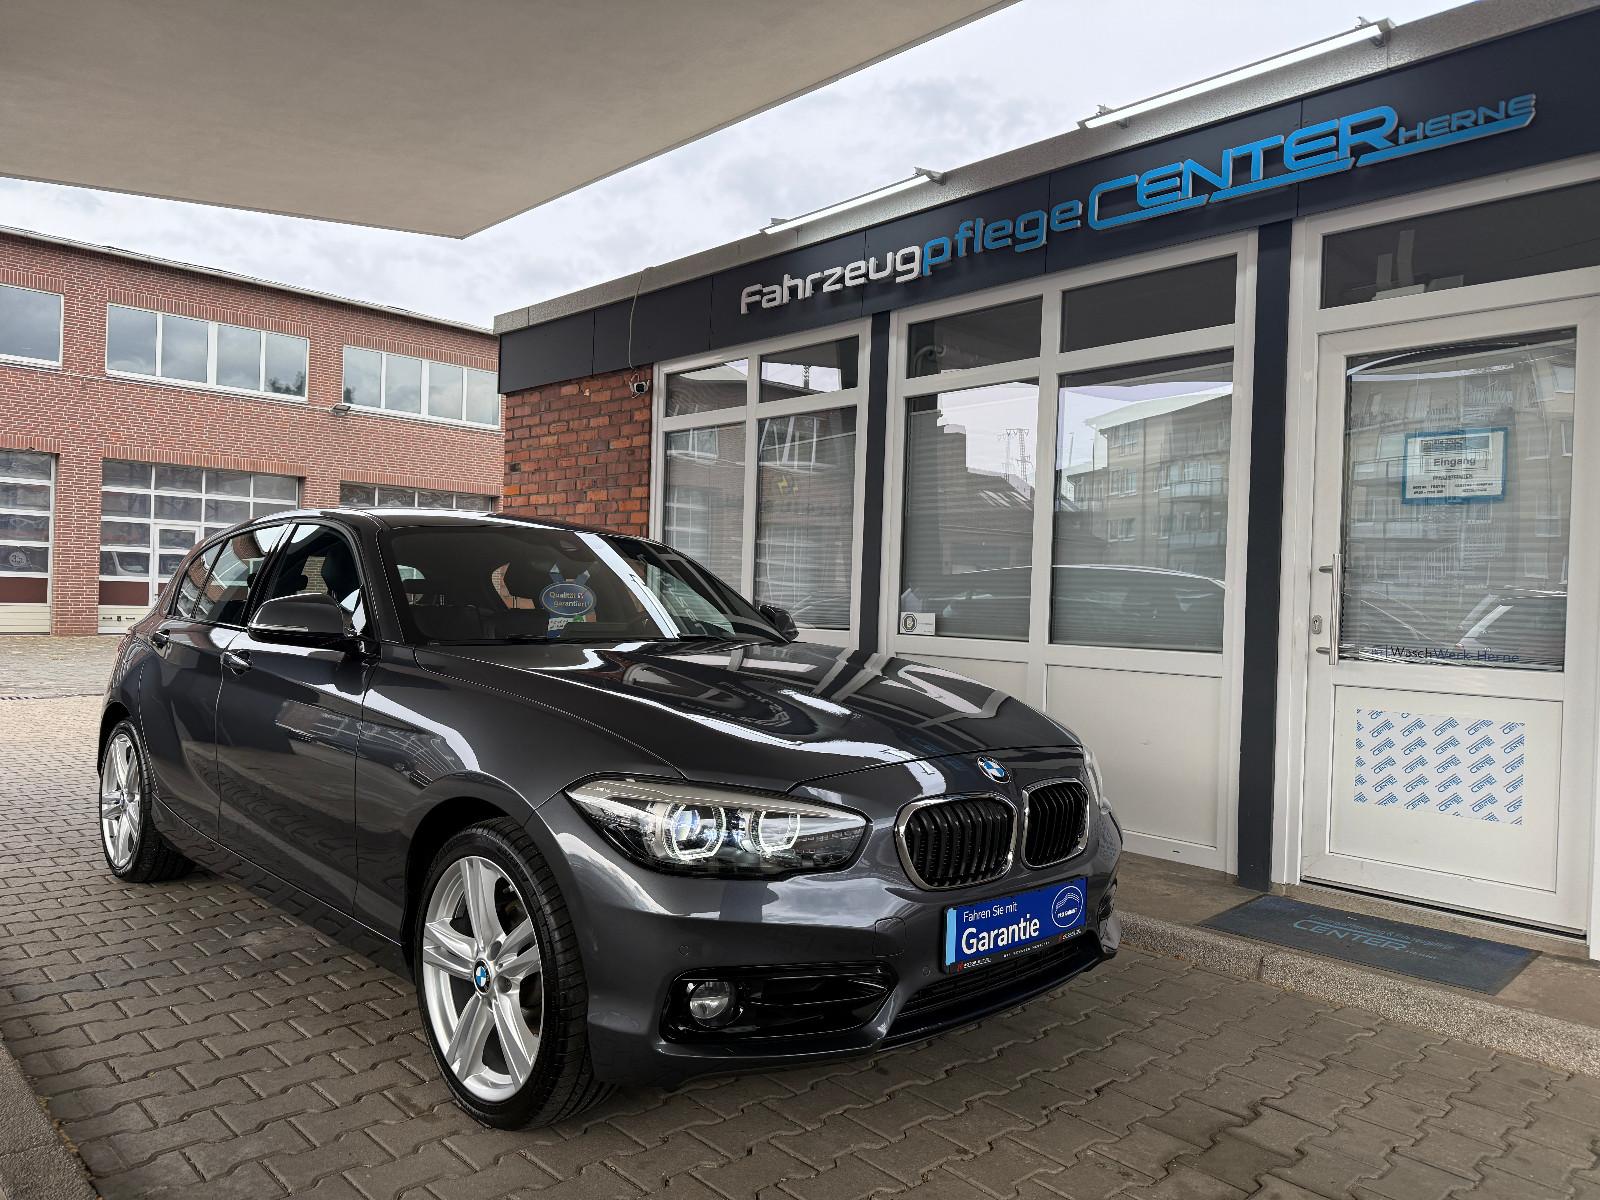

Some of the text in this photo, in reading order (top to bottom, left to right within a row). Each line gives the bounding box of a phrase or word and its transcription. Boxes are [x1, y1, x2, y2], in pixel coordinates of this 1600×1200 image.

[1088, 105, 1399, 231] CENTER
[1398, 94, 1536, 144] HERNE
[1434, 457, 1476, 468] Eingang
[963, 901, 1018, 923] Fahren Sie mit
[962, 913, 1040, 955] Garantie
